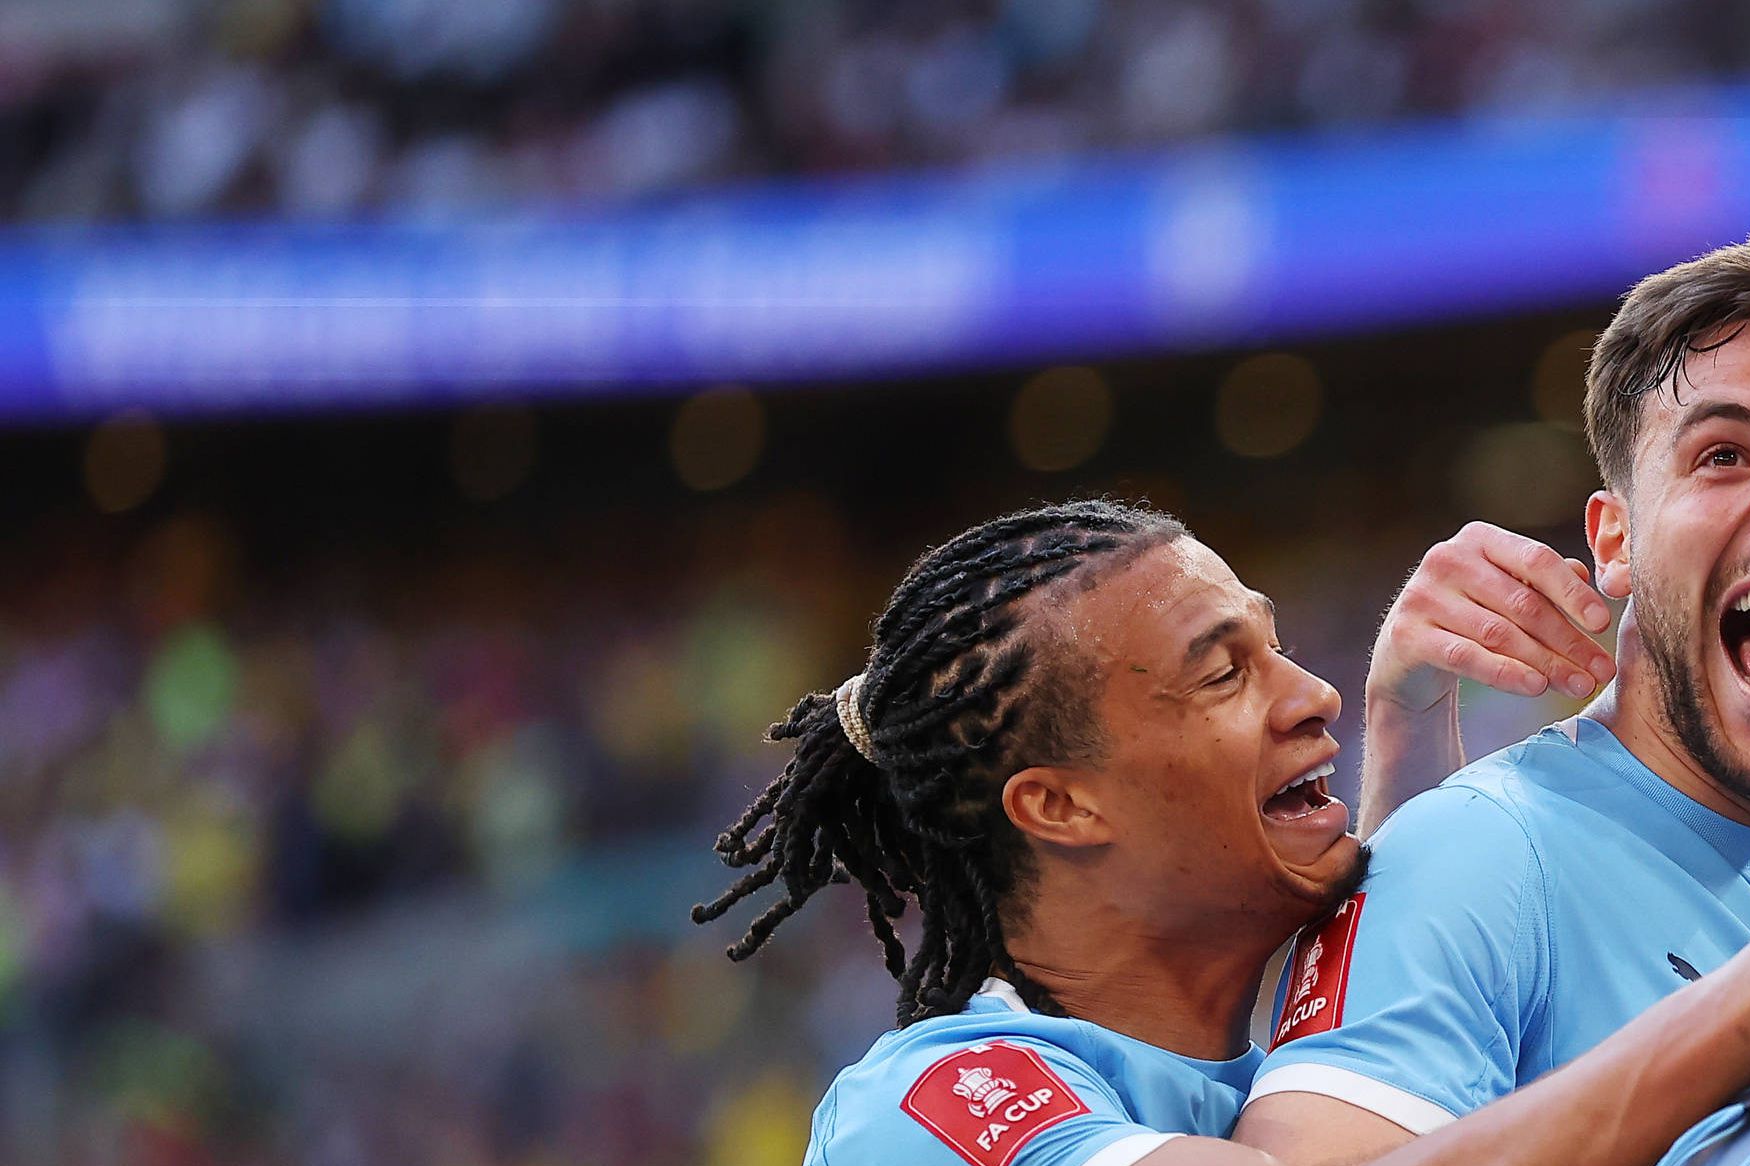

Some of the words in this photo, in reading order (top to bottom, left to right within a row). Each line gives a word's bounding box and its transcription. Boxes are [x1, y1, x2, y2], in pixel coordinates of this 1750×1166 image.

[1277, 1019, 1291, 1042] FA
[1292, 997, 1327, 1025] CUP
[975, 1122, 1010, 1151] FA
[1004, 1087, 1053, 1122] CUP
